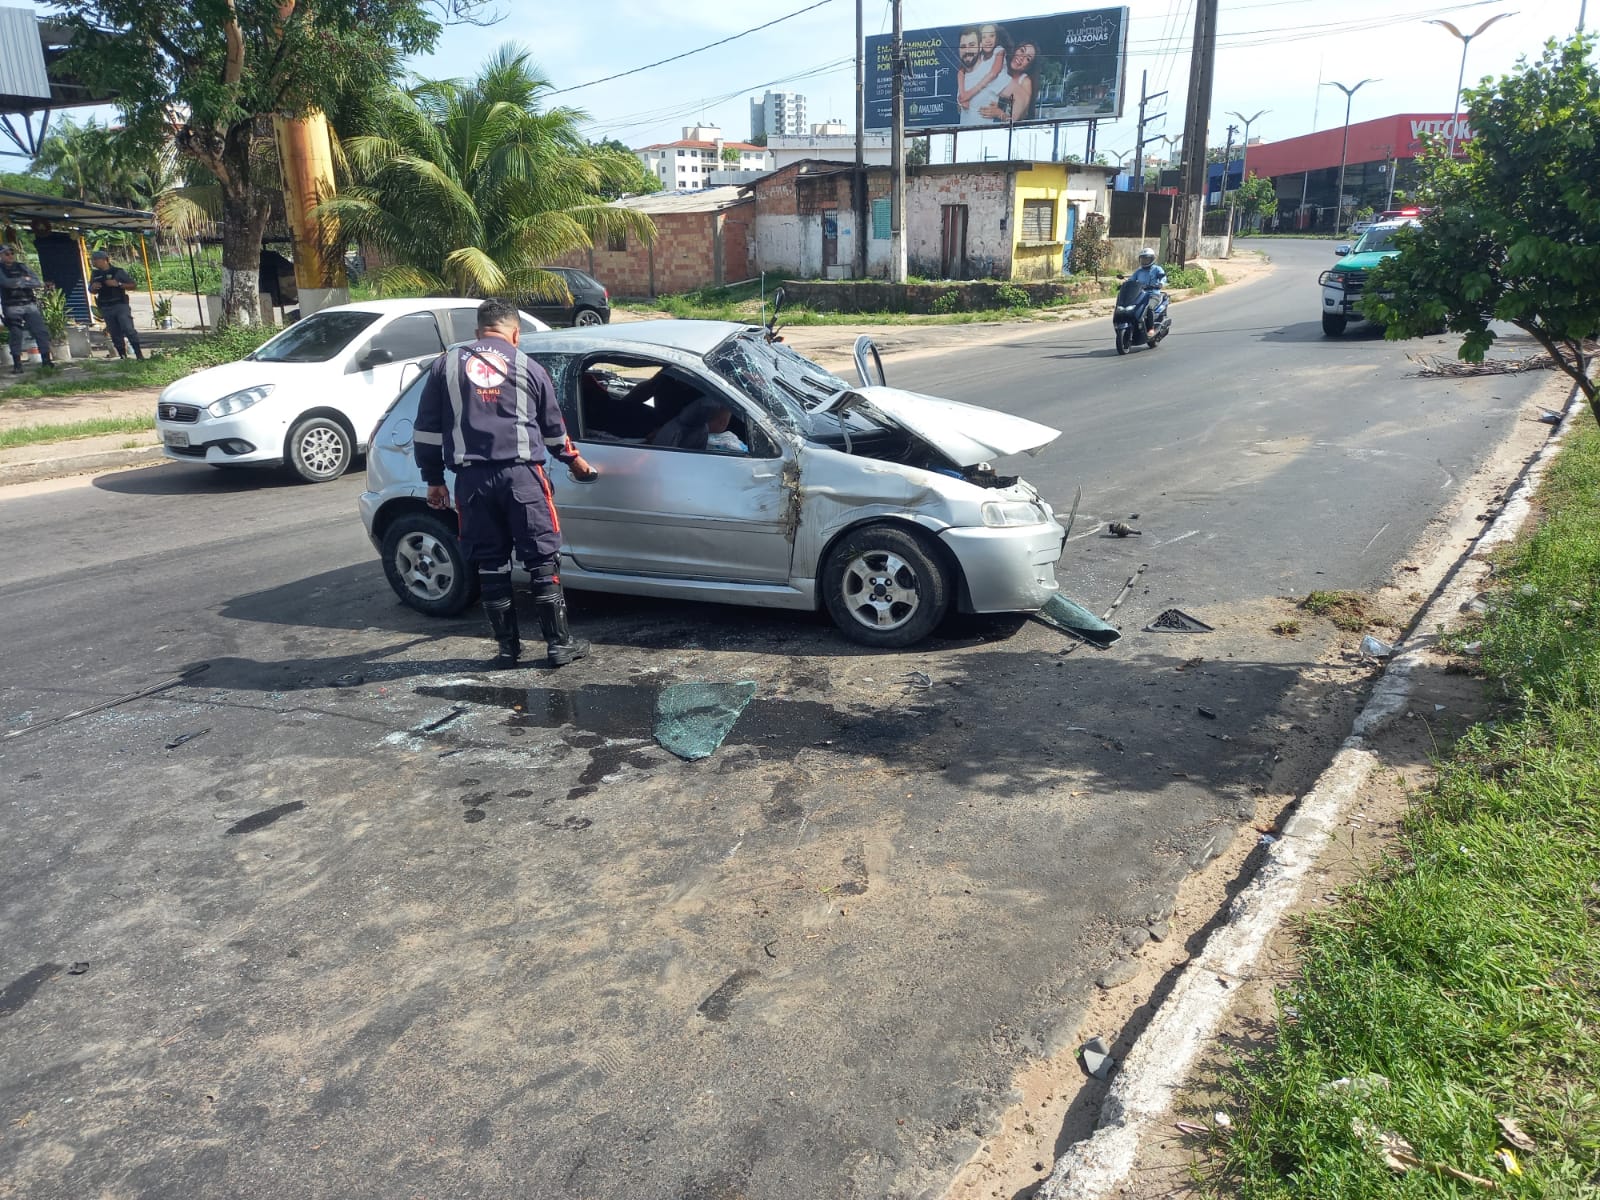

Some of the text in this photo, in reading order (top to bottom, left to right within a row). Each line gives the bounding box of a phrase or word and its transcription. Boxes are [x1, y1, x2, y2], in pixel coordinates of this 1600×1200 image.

[1064, 32, 1108, 44] AMAZONAS
[877, 63, 891, 71] POR
[918, 103, 944, 113] AMAZONAS
